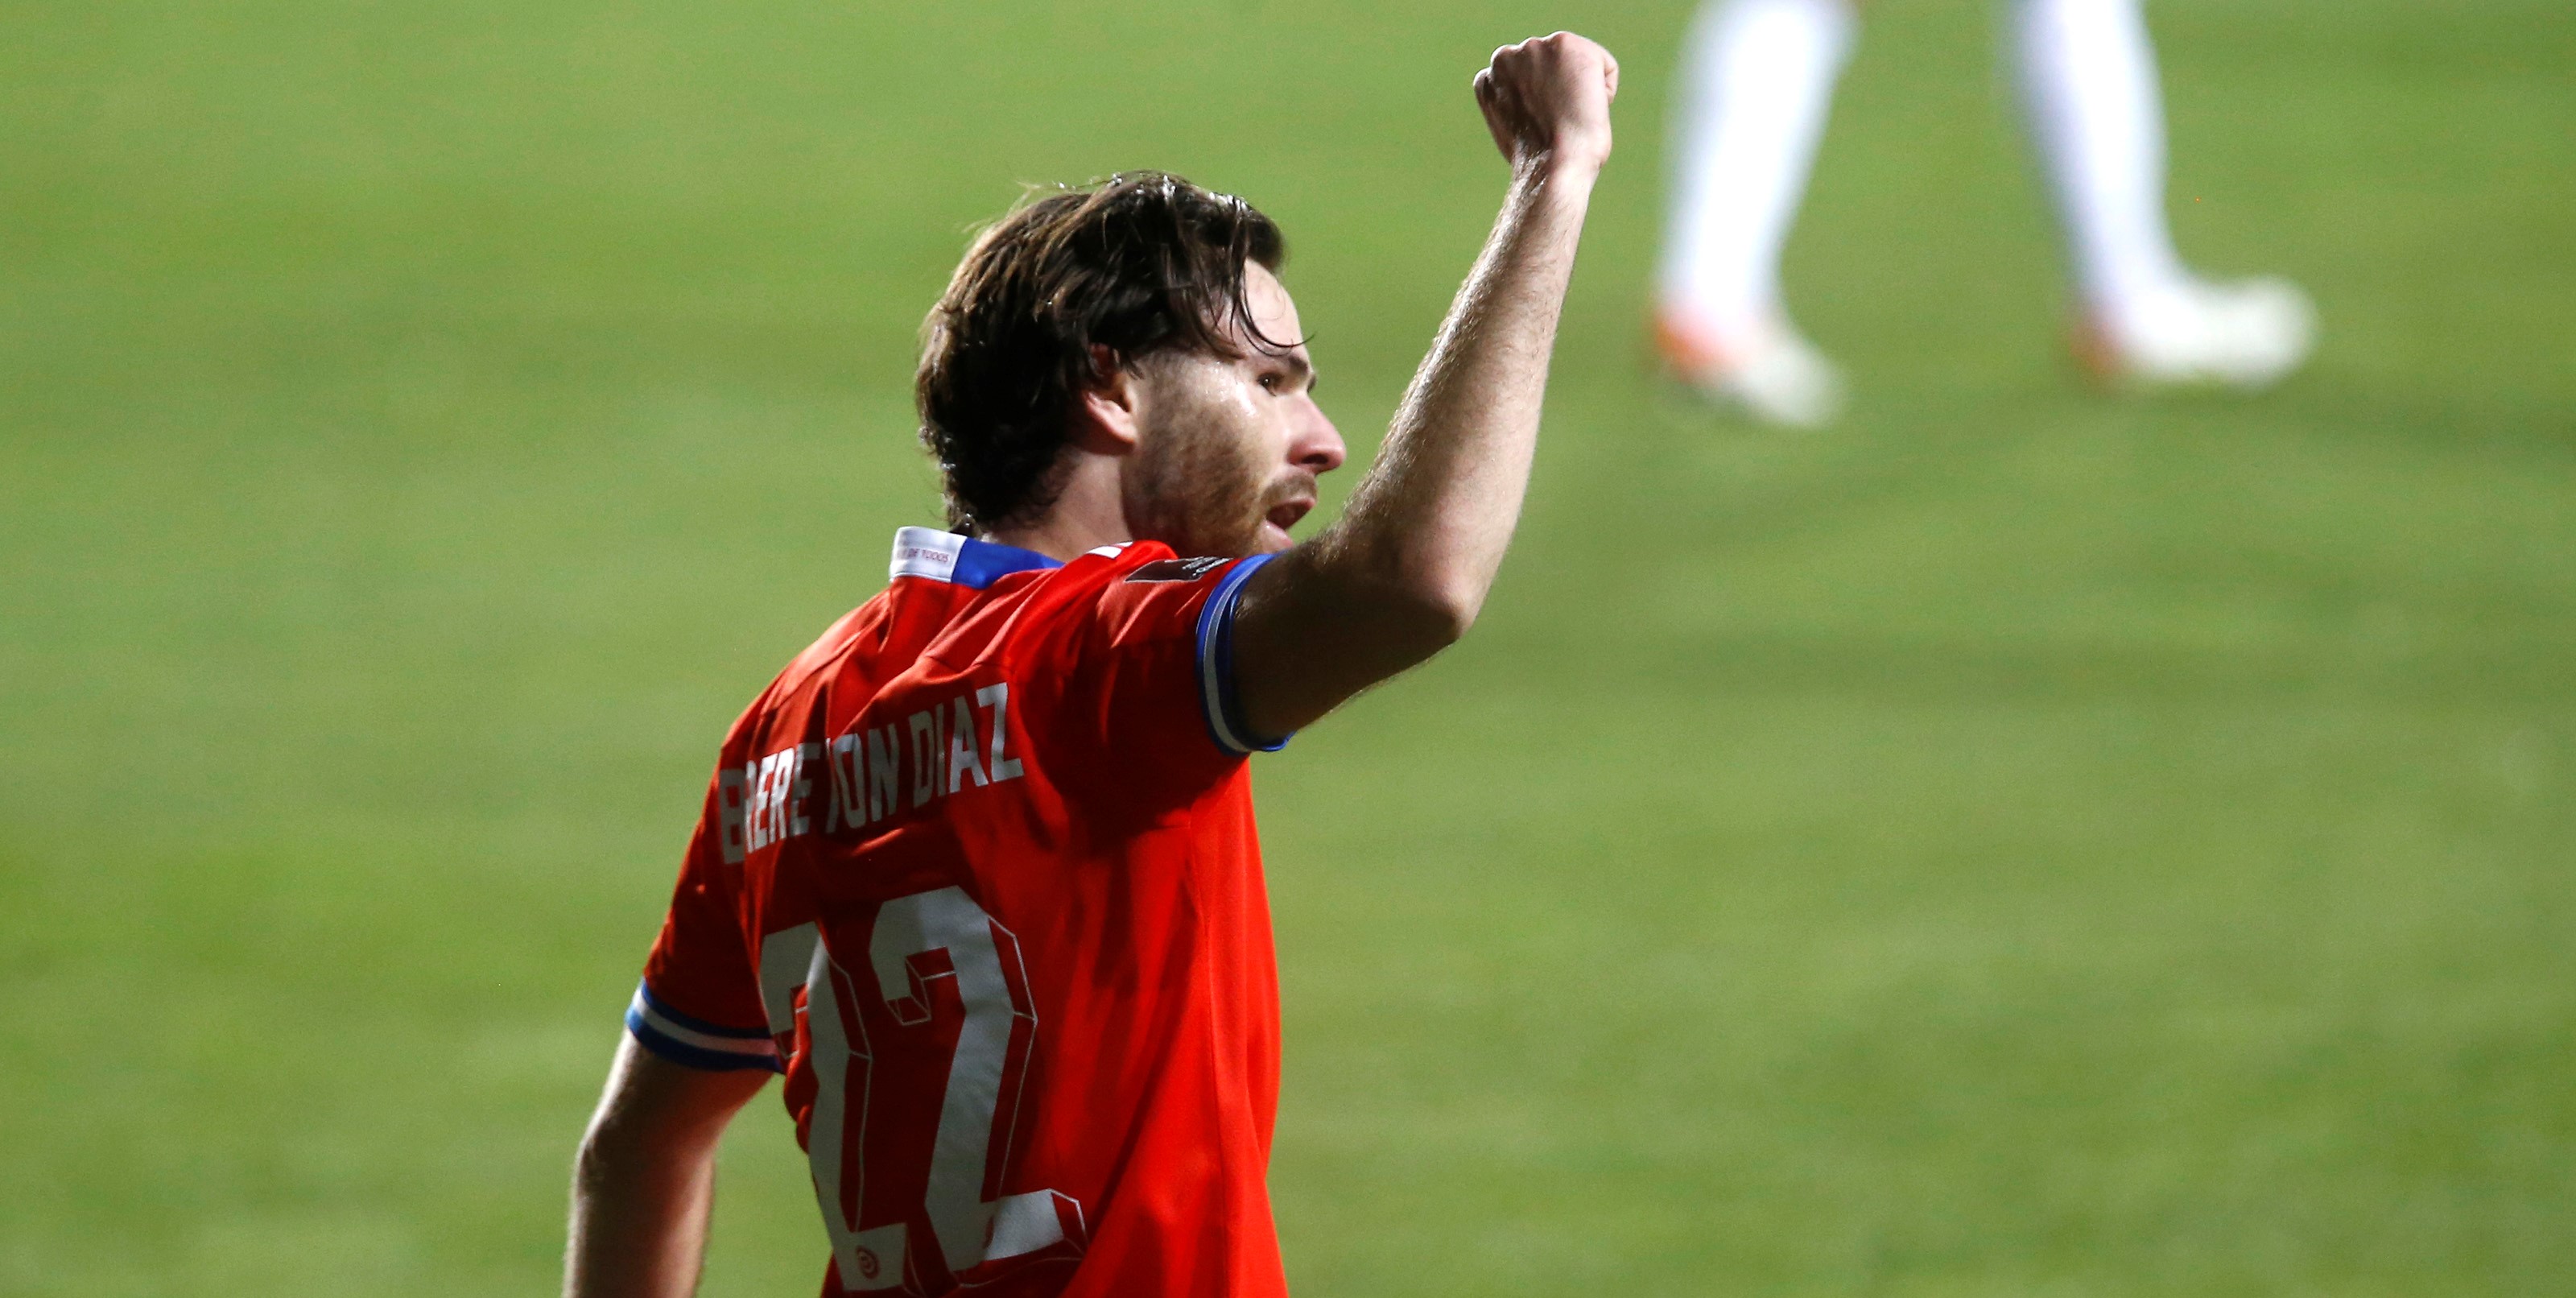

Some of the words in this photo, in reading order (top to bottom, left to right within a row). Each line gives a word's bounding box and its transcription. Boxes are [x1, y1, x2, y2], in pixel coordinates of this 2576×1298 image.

[922, 549, 949, 563] TODOS
[909, 682, 1024, 808] DIAZ
[759, 885, 1084, 1294] 22
